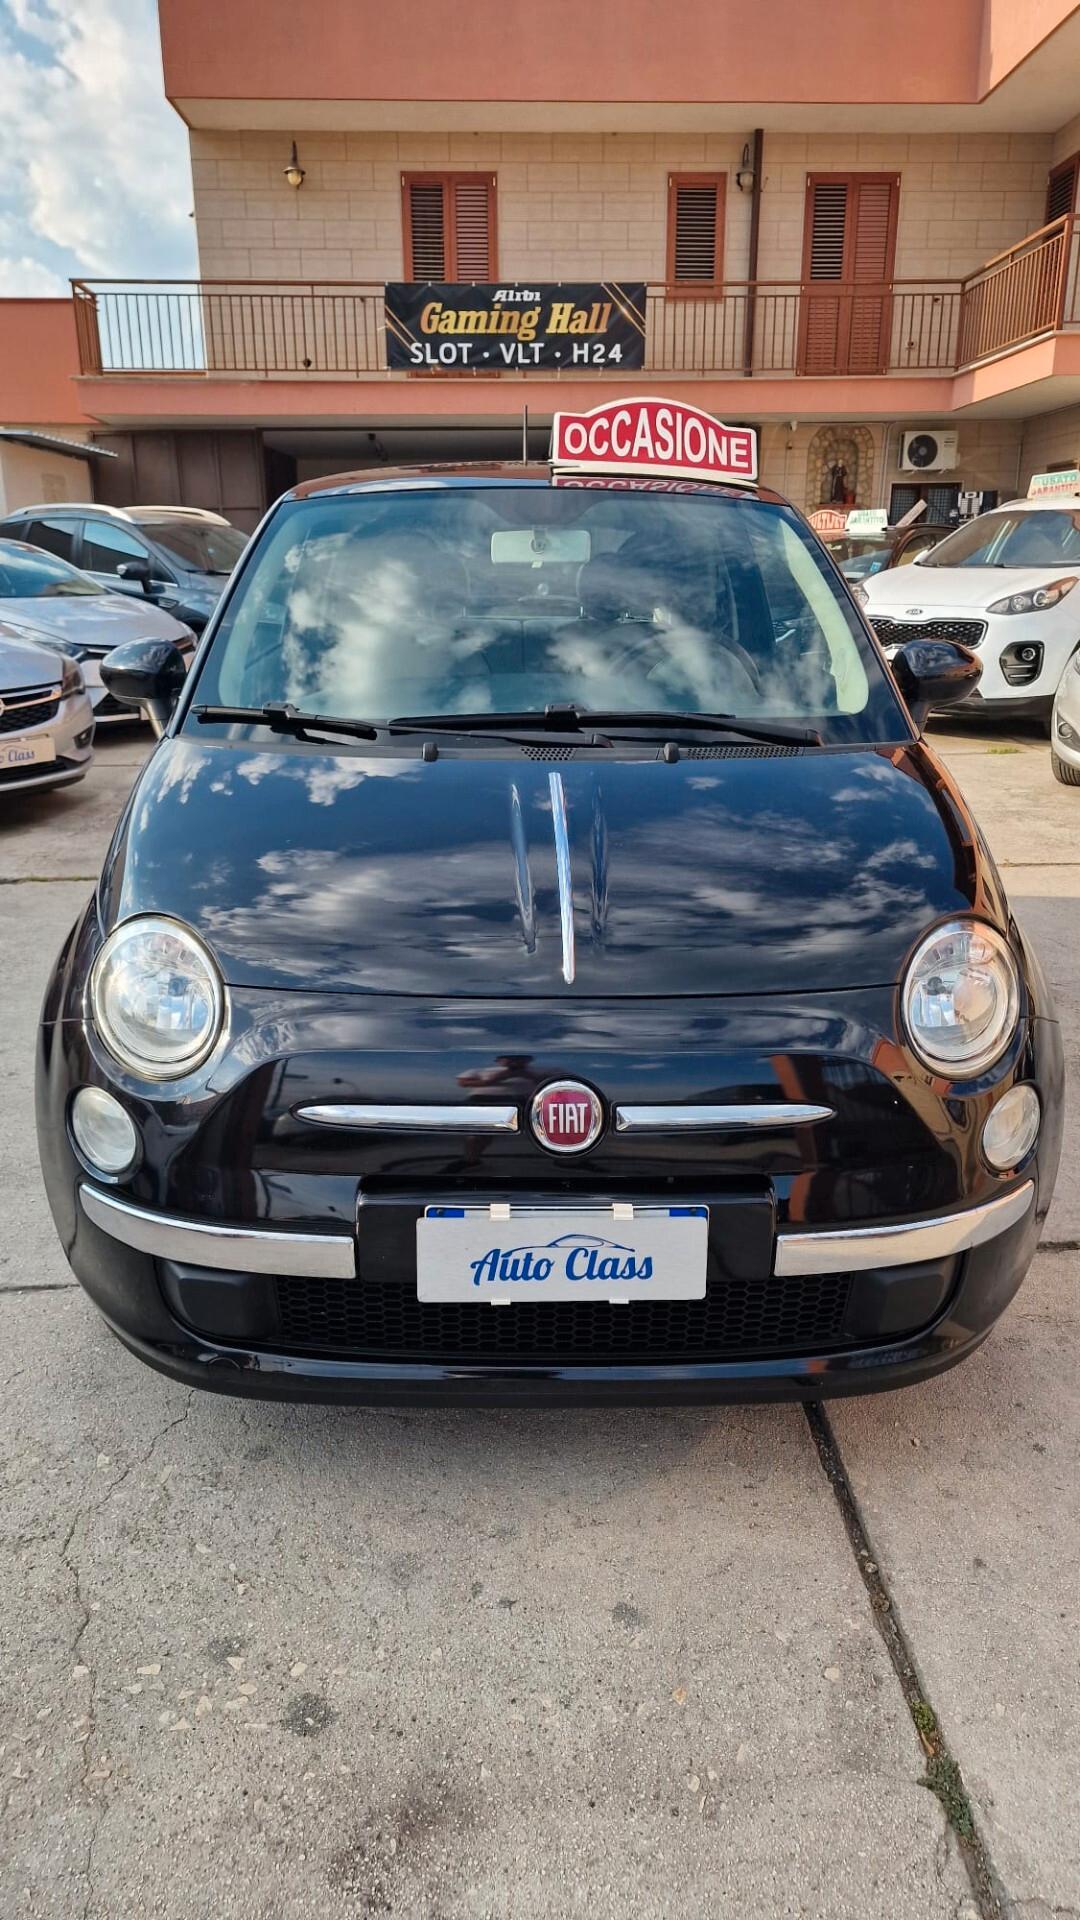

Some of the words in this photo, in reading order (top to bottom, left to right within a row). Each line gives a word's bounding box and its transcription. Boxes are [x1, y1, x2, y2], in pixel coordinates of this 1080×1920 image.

[420, 302, 541, 341] Gaming
[545, 302, 613, 334] Hall
[410, 342, 473, 364] SLOT
[500, 342, 545, 364] VLT
[572, 343, 623, 364] H24
[564, 407, 749, 468] OCCASIONE
[549, 1102, 588, 1134] FIAT
[470, 1248, 554, 1286] Auto
[565, 1247, 653, 1282] Class
